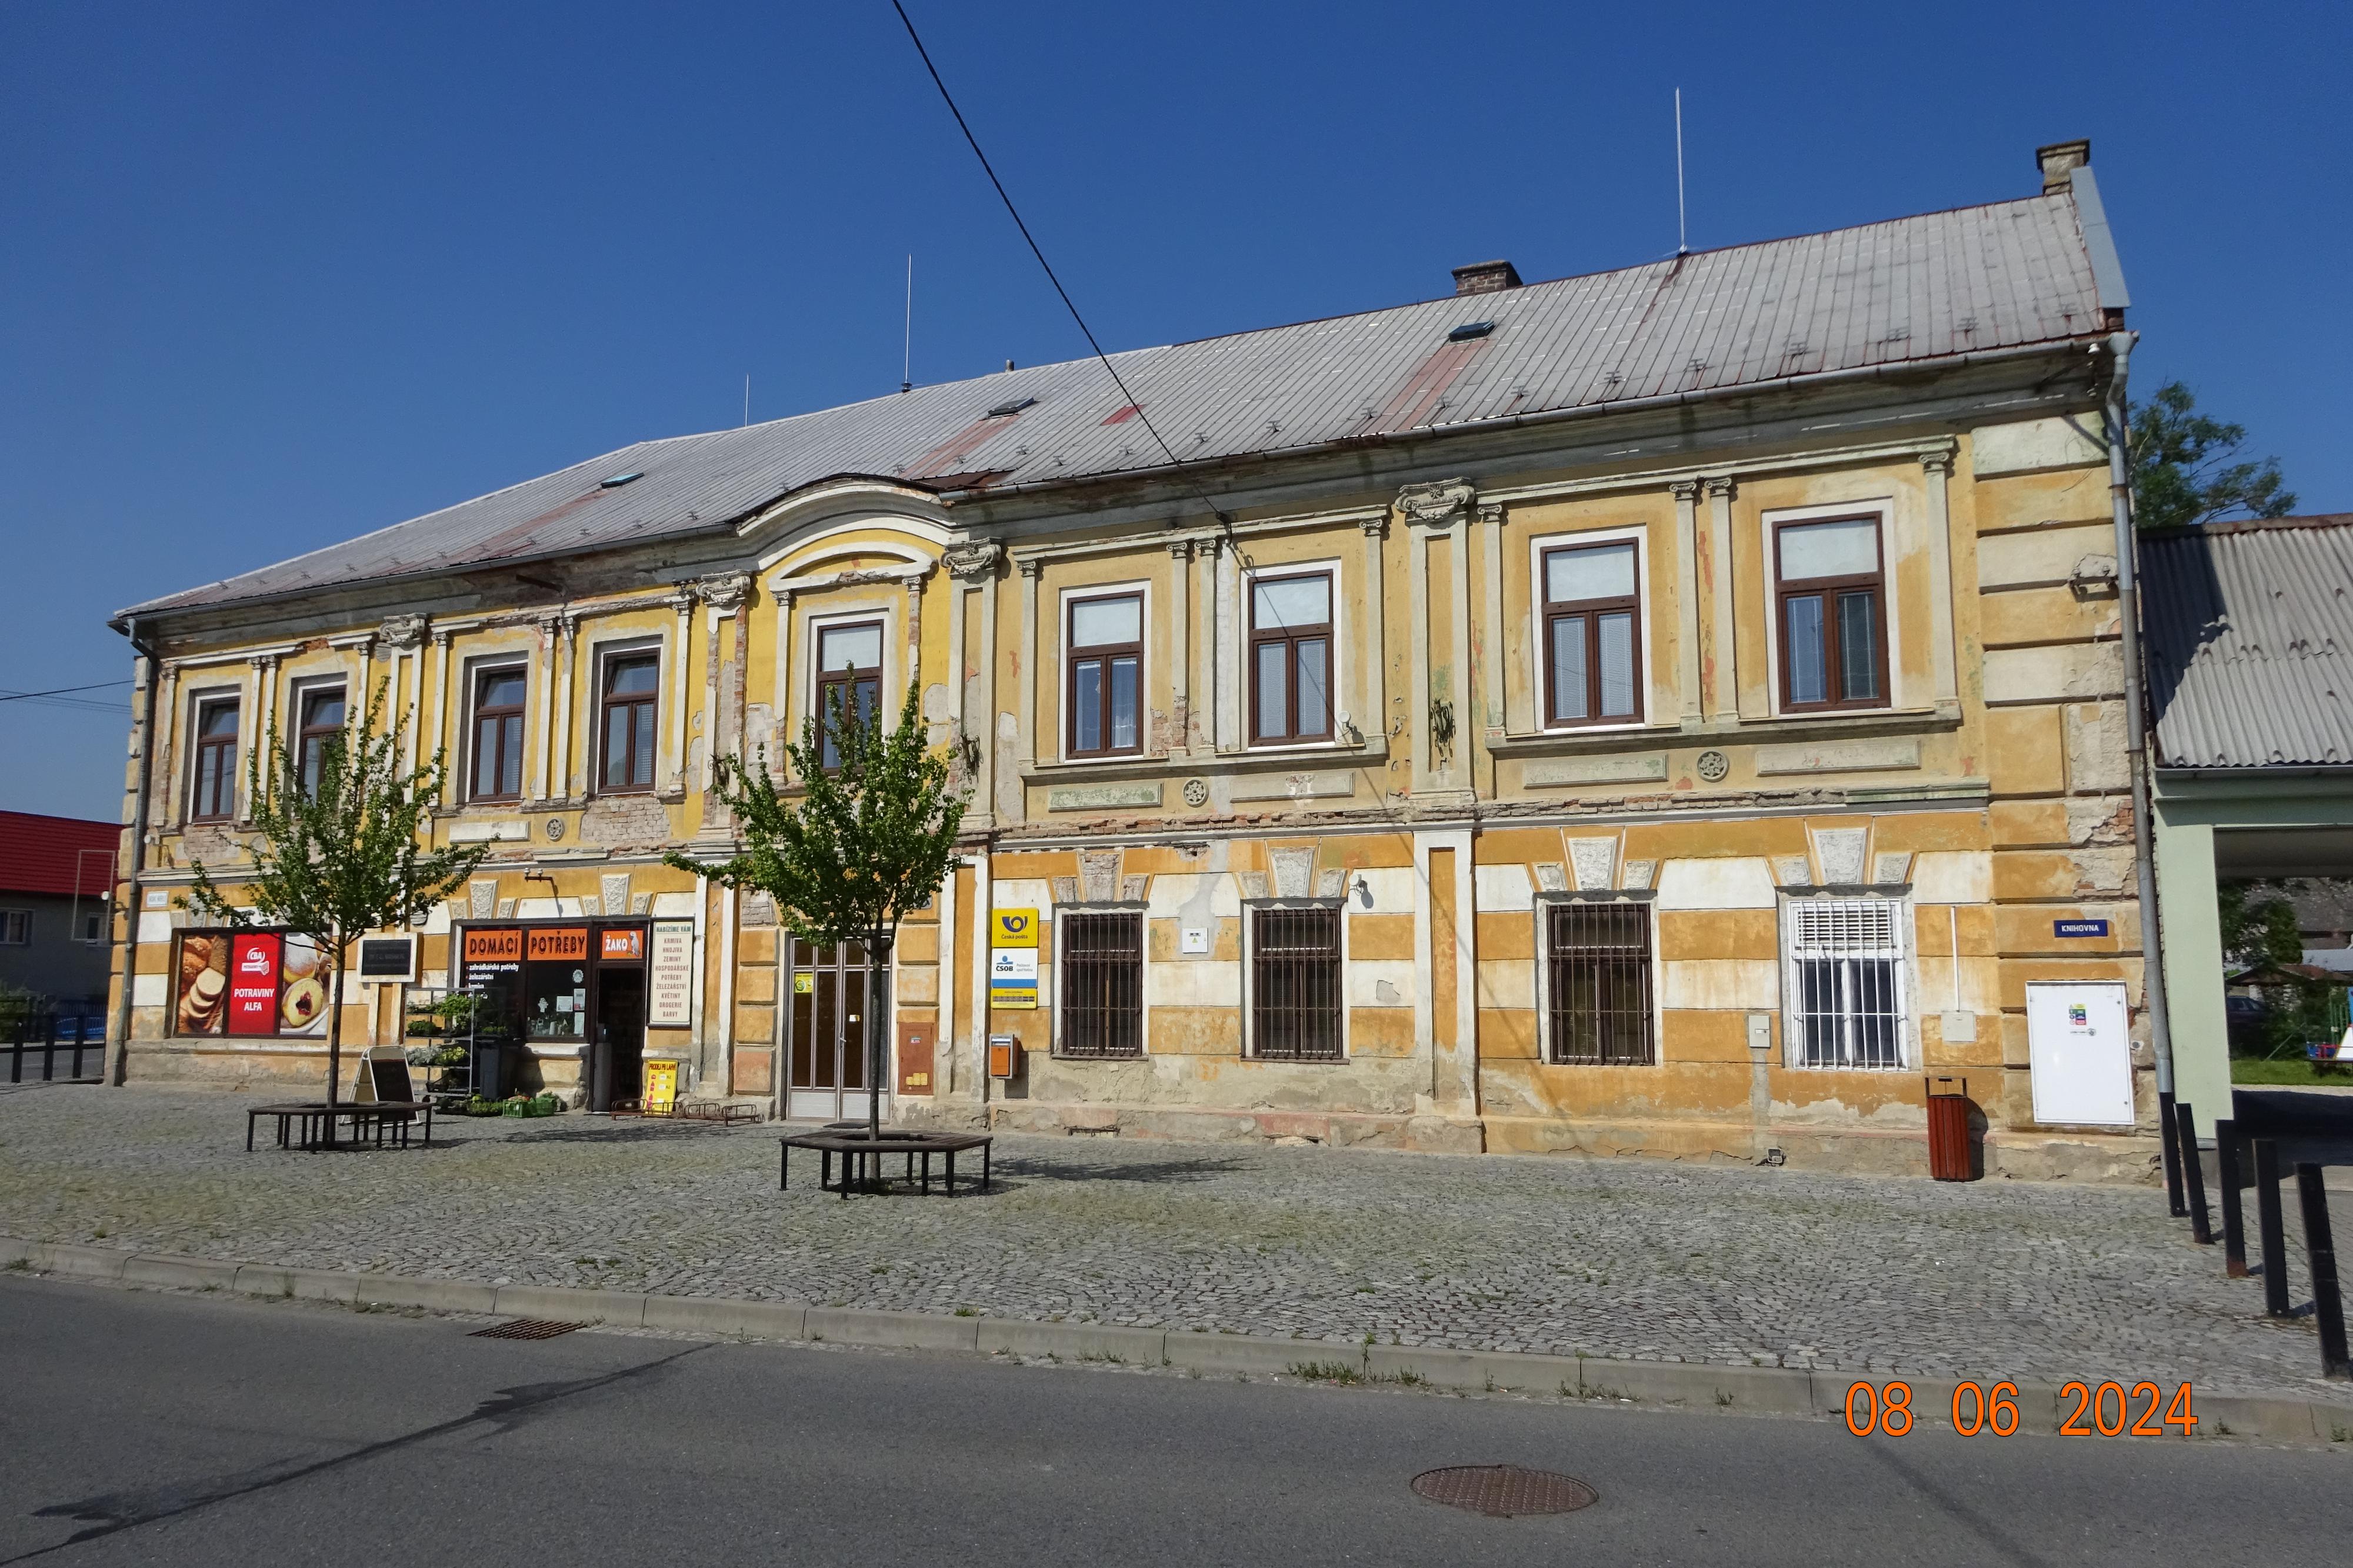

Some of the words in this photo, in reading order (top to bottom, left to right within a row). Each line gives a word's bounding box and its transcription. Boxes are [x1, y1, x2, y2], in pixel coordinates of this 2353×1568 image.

[469, 932, 519, 955] DOMÁCÍ
[531, 930, 585, 955] POTŘEBY
[605, 934, 628, 952] ŽAKO
[250, 952, 262, 960] CBA
[234, 989, 275, 997] POTRAVINY
[244, 1002, 262, 1011] ALFA
